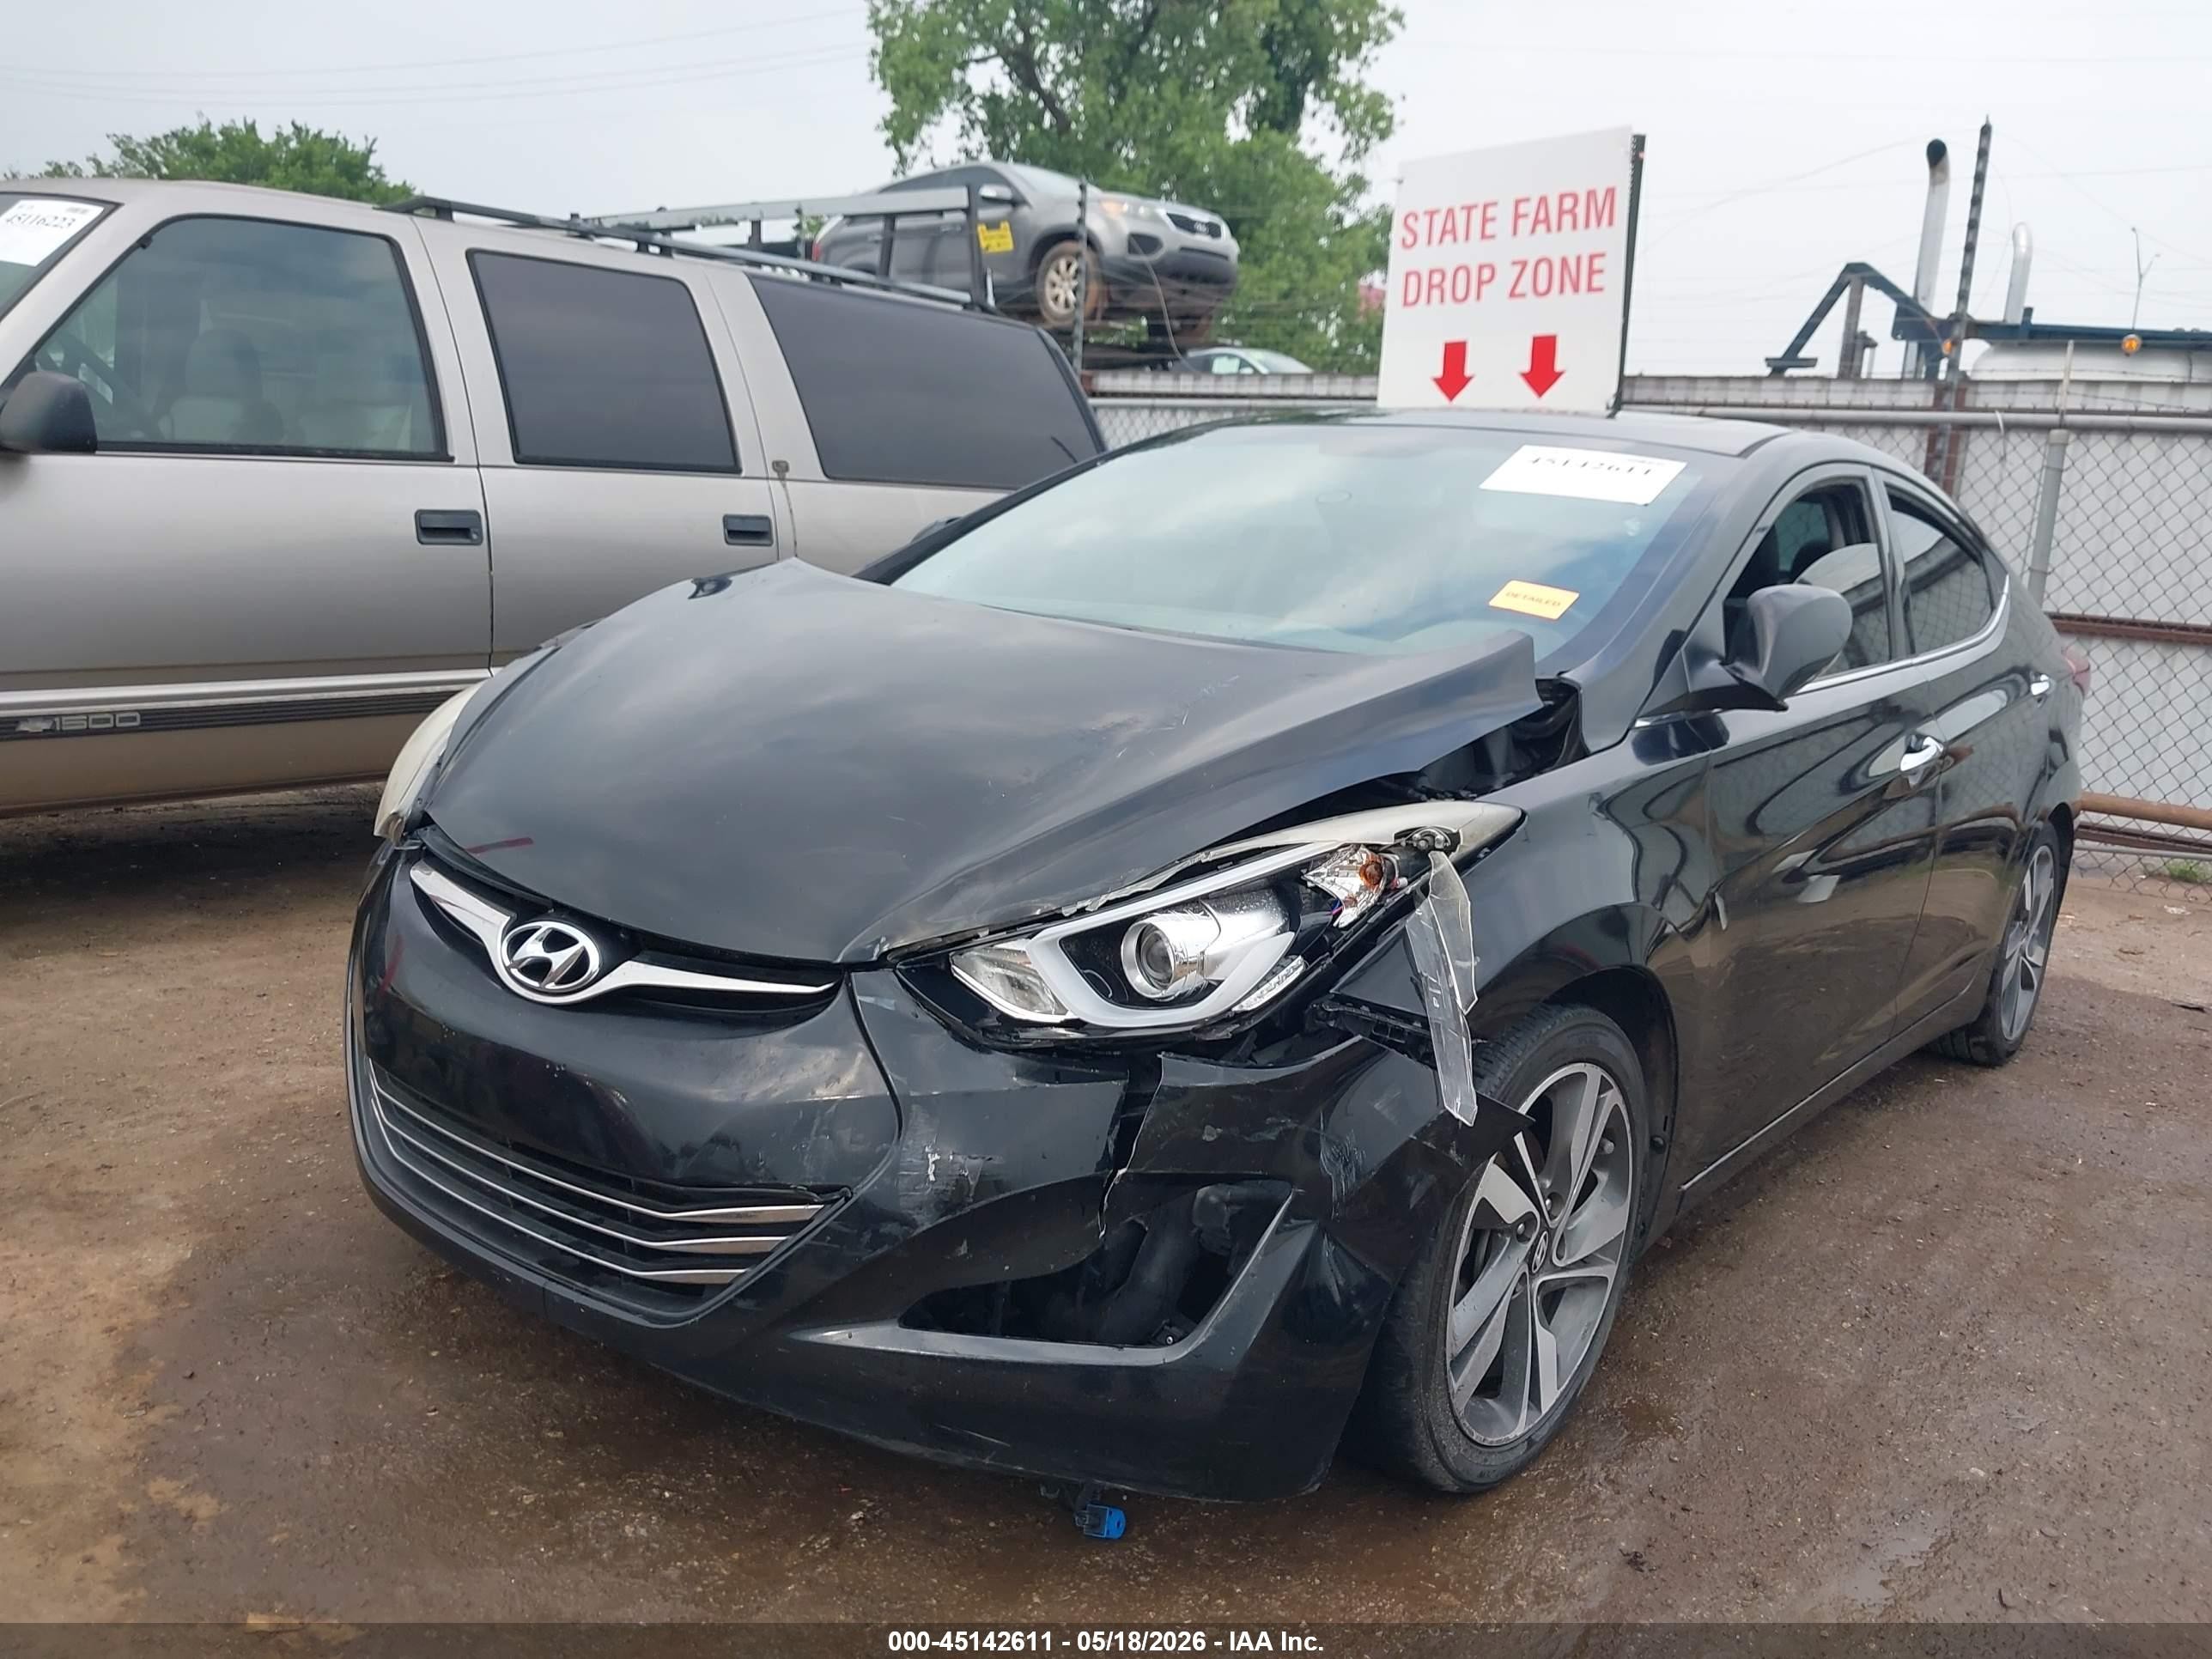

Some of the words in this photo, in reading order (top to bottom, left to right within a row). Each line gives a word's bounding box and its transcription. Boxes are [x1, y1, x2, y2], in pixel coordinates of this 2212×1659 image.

[1401, 202, 1498, 250] STATE
[1511, 186, 1616, 236] FARM
[1402, 263, 1496, 307] DROP
[1508, 252, 1606, 298] ZONE
[54, 711, 141, 731] 1500
